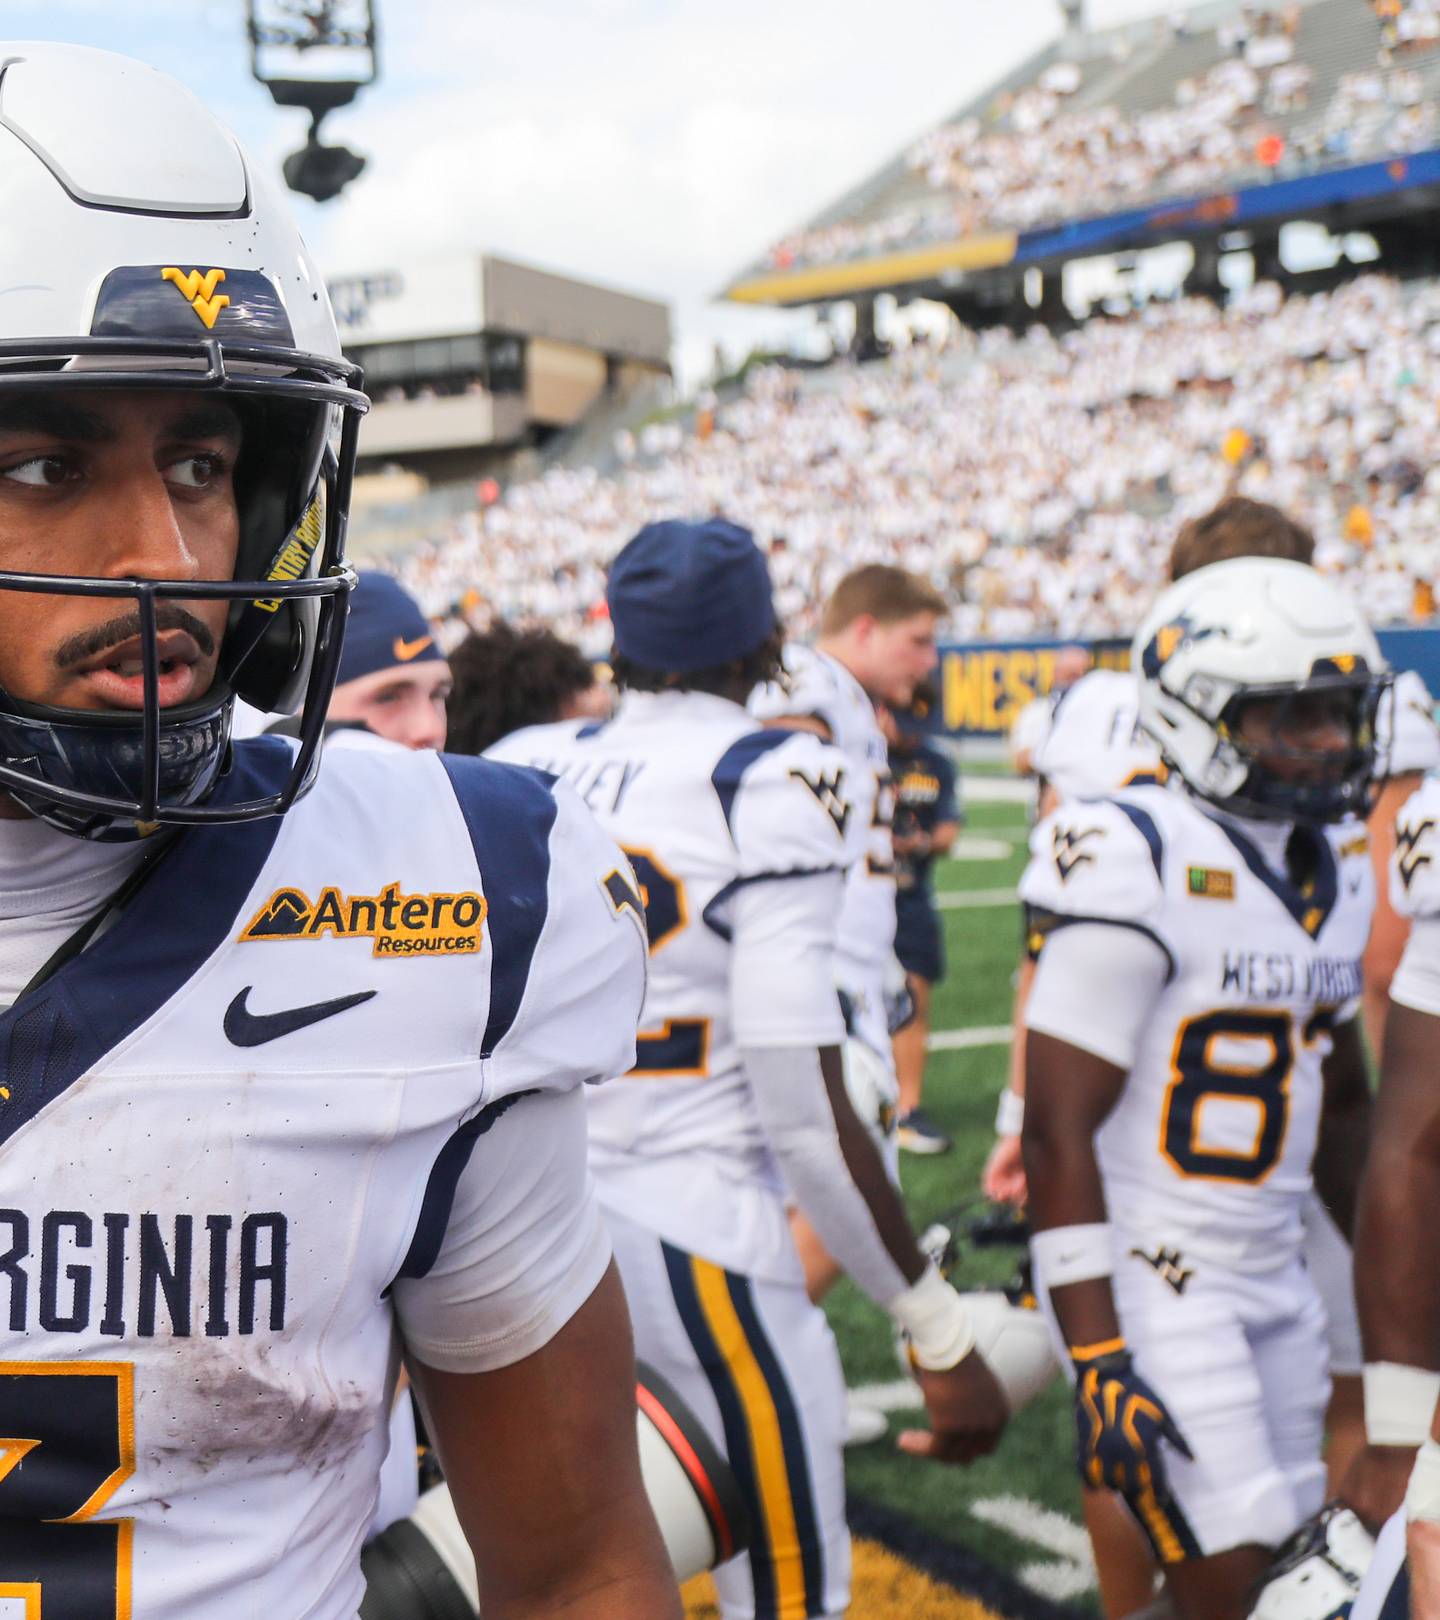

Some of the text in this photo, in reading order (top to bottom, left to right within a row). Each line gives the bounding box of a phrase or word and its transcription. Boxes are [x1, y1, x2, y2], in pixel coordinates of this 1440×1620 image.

[310, 887, 482, 934] Antero
[376, 934, 477, 953] Resources
[1220, 951, 1297, 998] WEST
